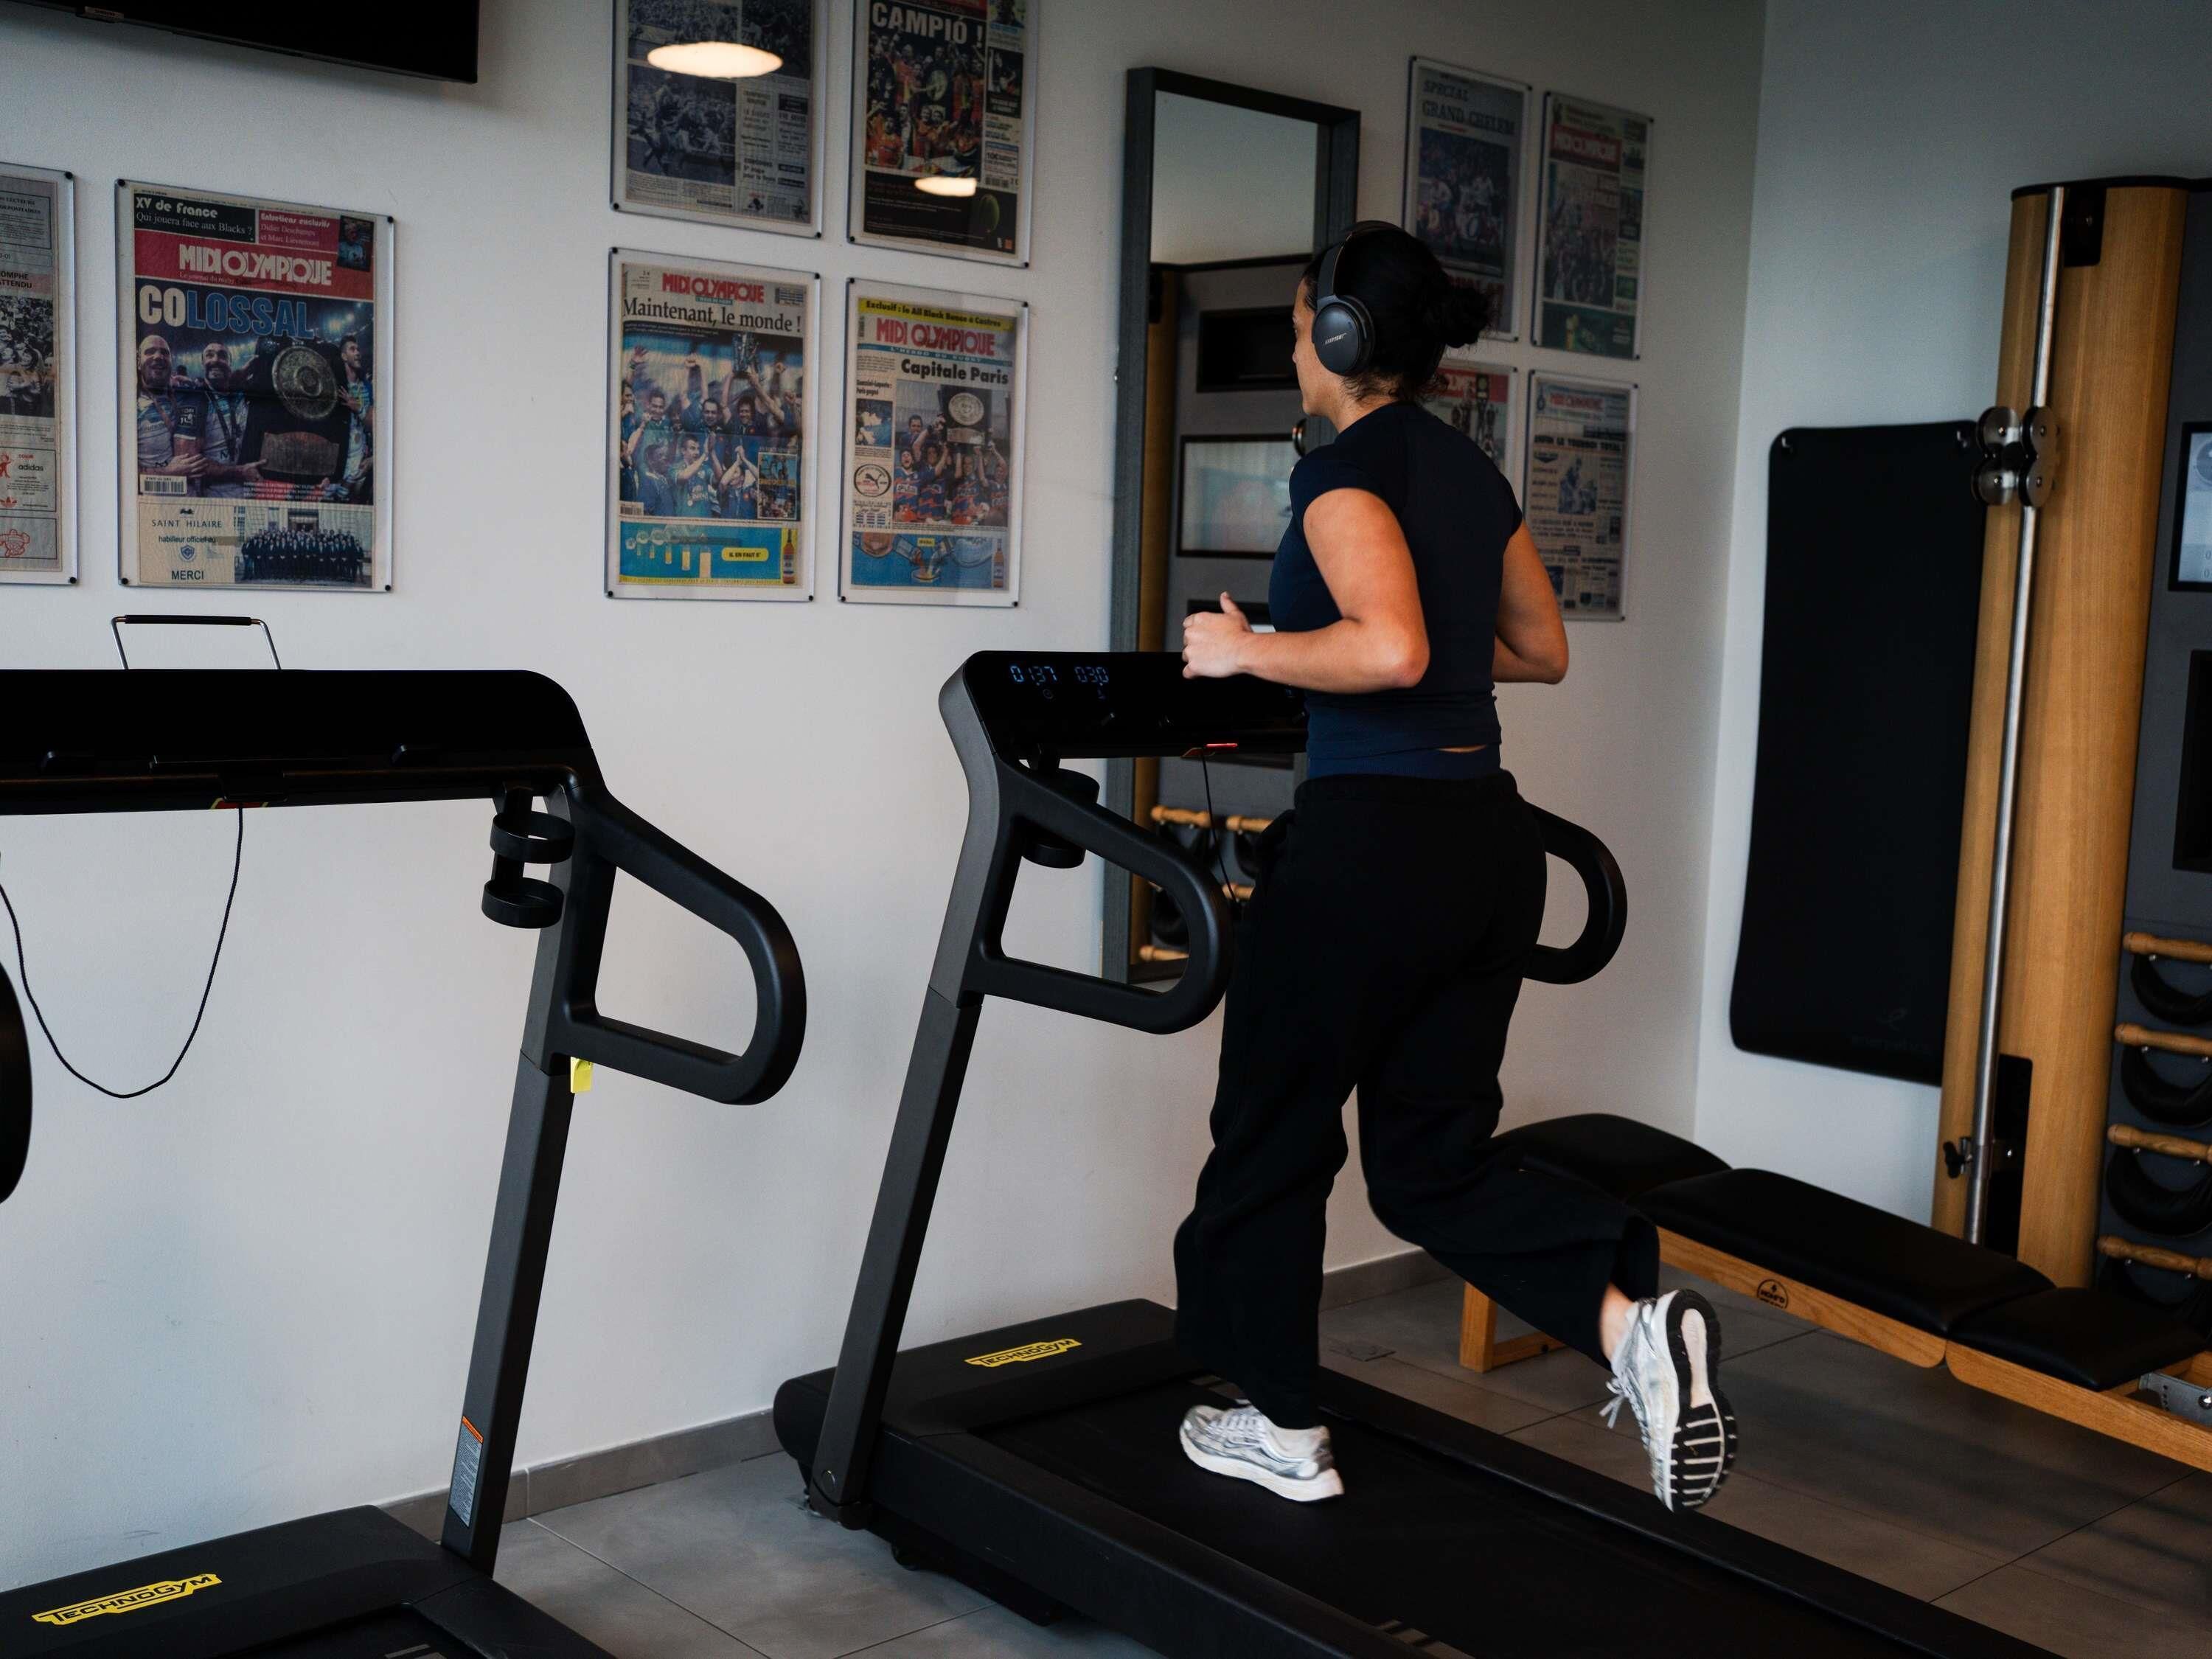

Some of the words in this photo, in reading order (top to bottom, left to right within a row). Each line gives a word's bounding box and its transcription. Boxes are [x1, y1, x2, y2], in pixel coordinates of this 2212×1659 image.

[136, 197, 152, 209] XV
[155, 200, 172, 212] de
[136, 212, 152, 222] Qui
[153, 213, 180, 226] jouera
[182, 218, 200, 229] face
[218, 222, 246, 234] Blacks
[179, 244, 221, 274] MIDI
[222, 250, 333, 286] OLYMPIQUE
[662, 272, 690, 295] MIDI
[692, 276, 765, 304] OLYMPIQUE
[139, 285, 315, 339] COLOSSAL
[624, 297, 717, 327] Maintenant,
[722, 306, 735, 324] le
[740, 313, 793, 332] monde
[866, 300, 897, 311] Exclusif
[911, 307, 922, 316] All
[923, 309, 944, 319] Black
[876, 318, 908, 345] MIDI
[911, 323, 996, 356] OLYMPIQUE
[901, 358, 967, 380] Capitale
[970, 366, 1009, 384] Paris
[18, 464, 44, 472] adidas
[152, 519, 180, 528] SAINT
[186, 520, 223, 529] HILAIRE
[159, 535, 185, 543] habilleur
[171, 570, 204, 580] MERCI
[970, 1339, 1075, 1365] TECHNOGYM
[38, 1575, 214, 1622] TECHNOGYM
